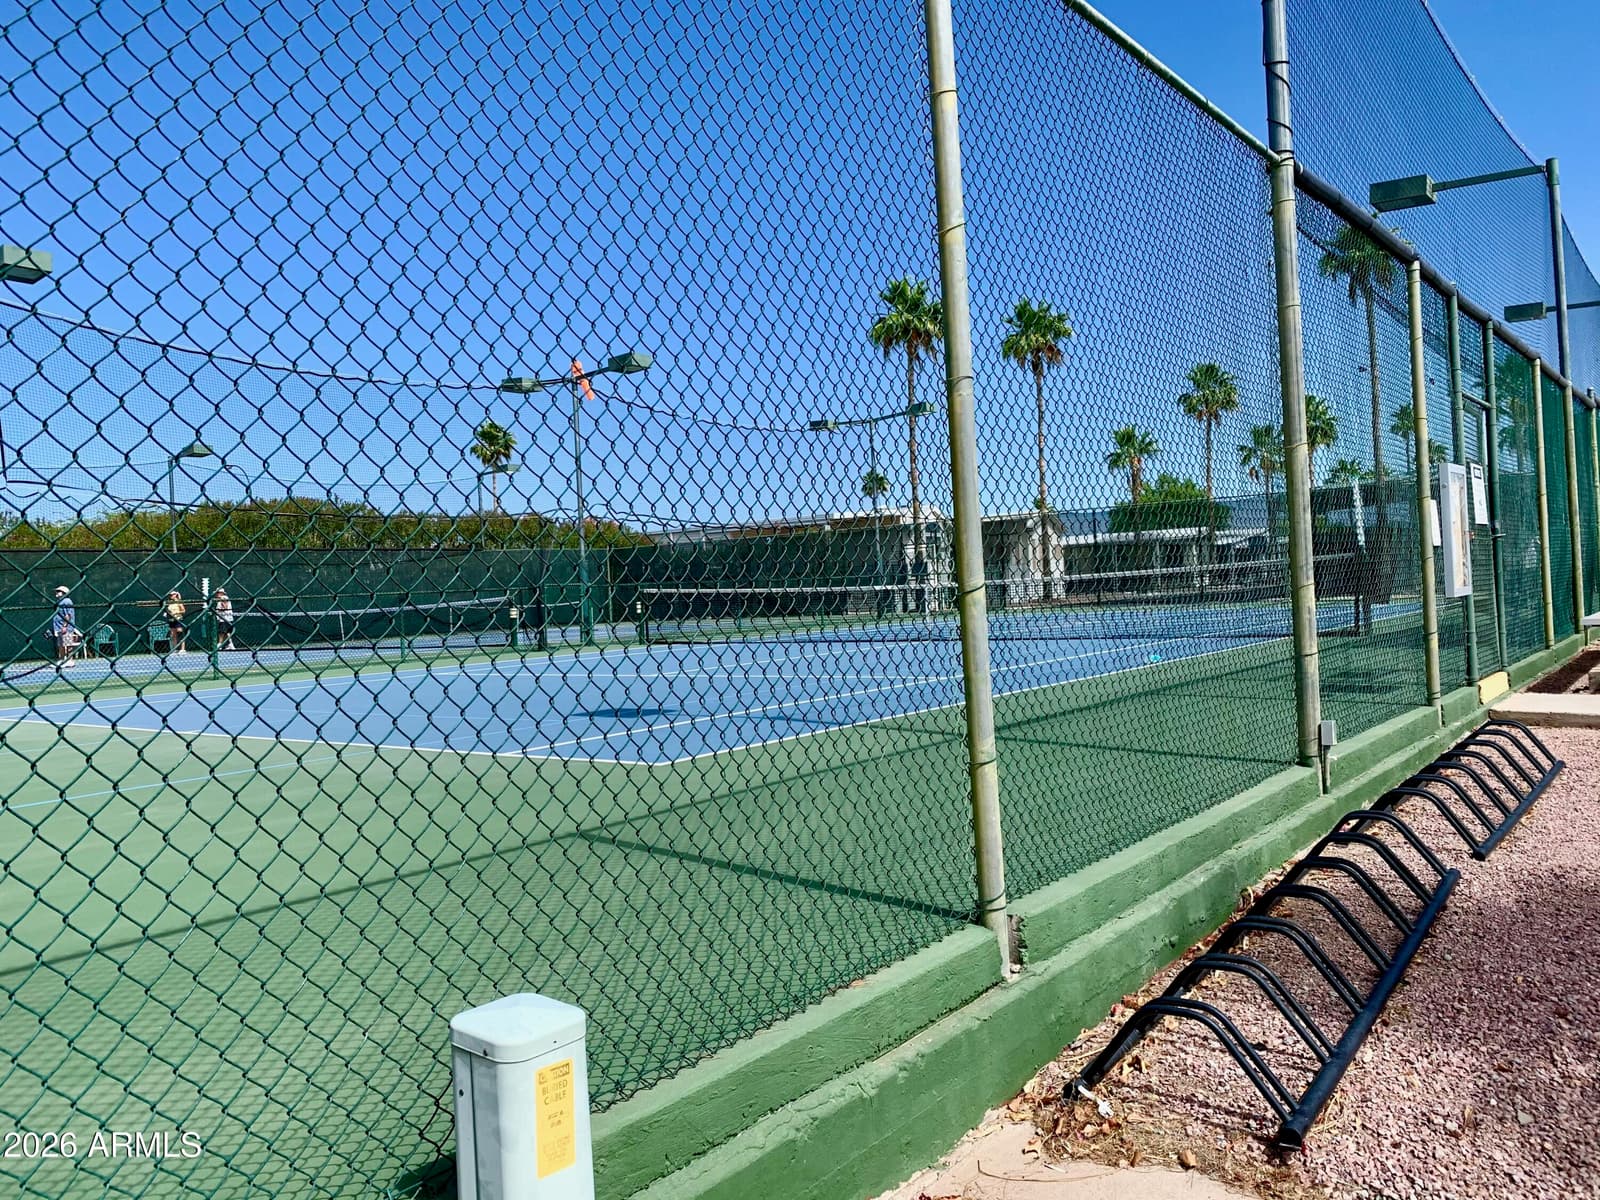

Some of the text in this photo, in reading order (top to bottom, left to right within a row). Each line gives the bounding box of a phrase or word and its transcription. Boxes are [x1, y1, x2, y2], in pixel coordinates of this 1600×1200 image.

[539, 1064, 569, 1083] CTION
[542, 1079, 568, 1096] BIED
[543, 1090, 567, 1106] CBLE
